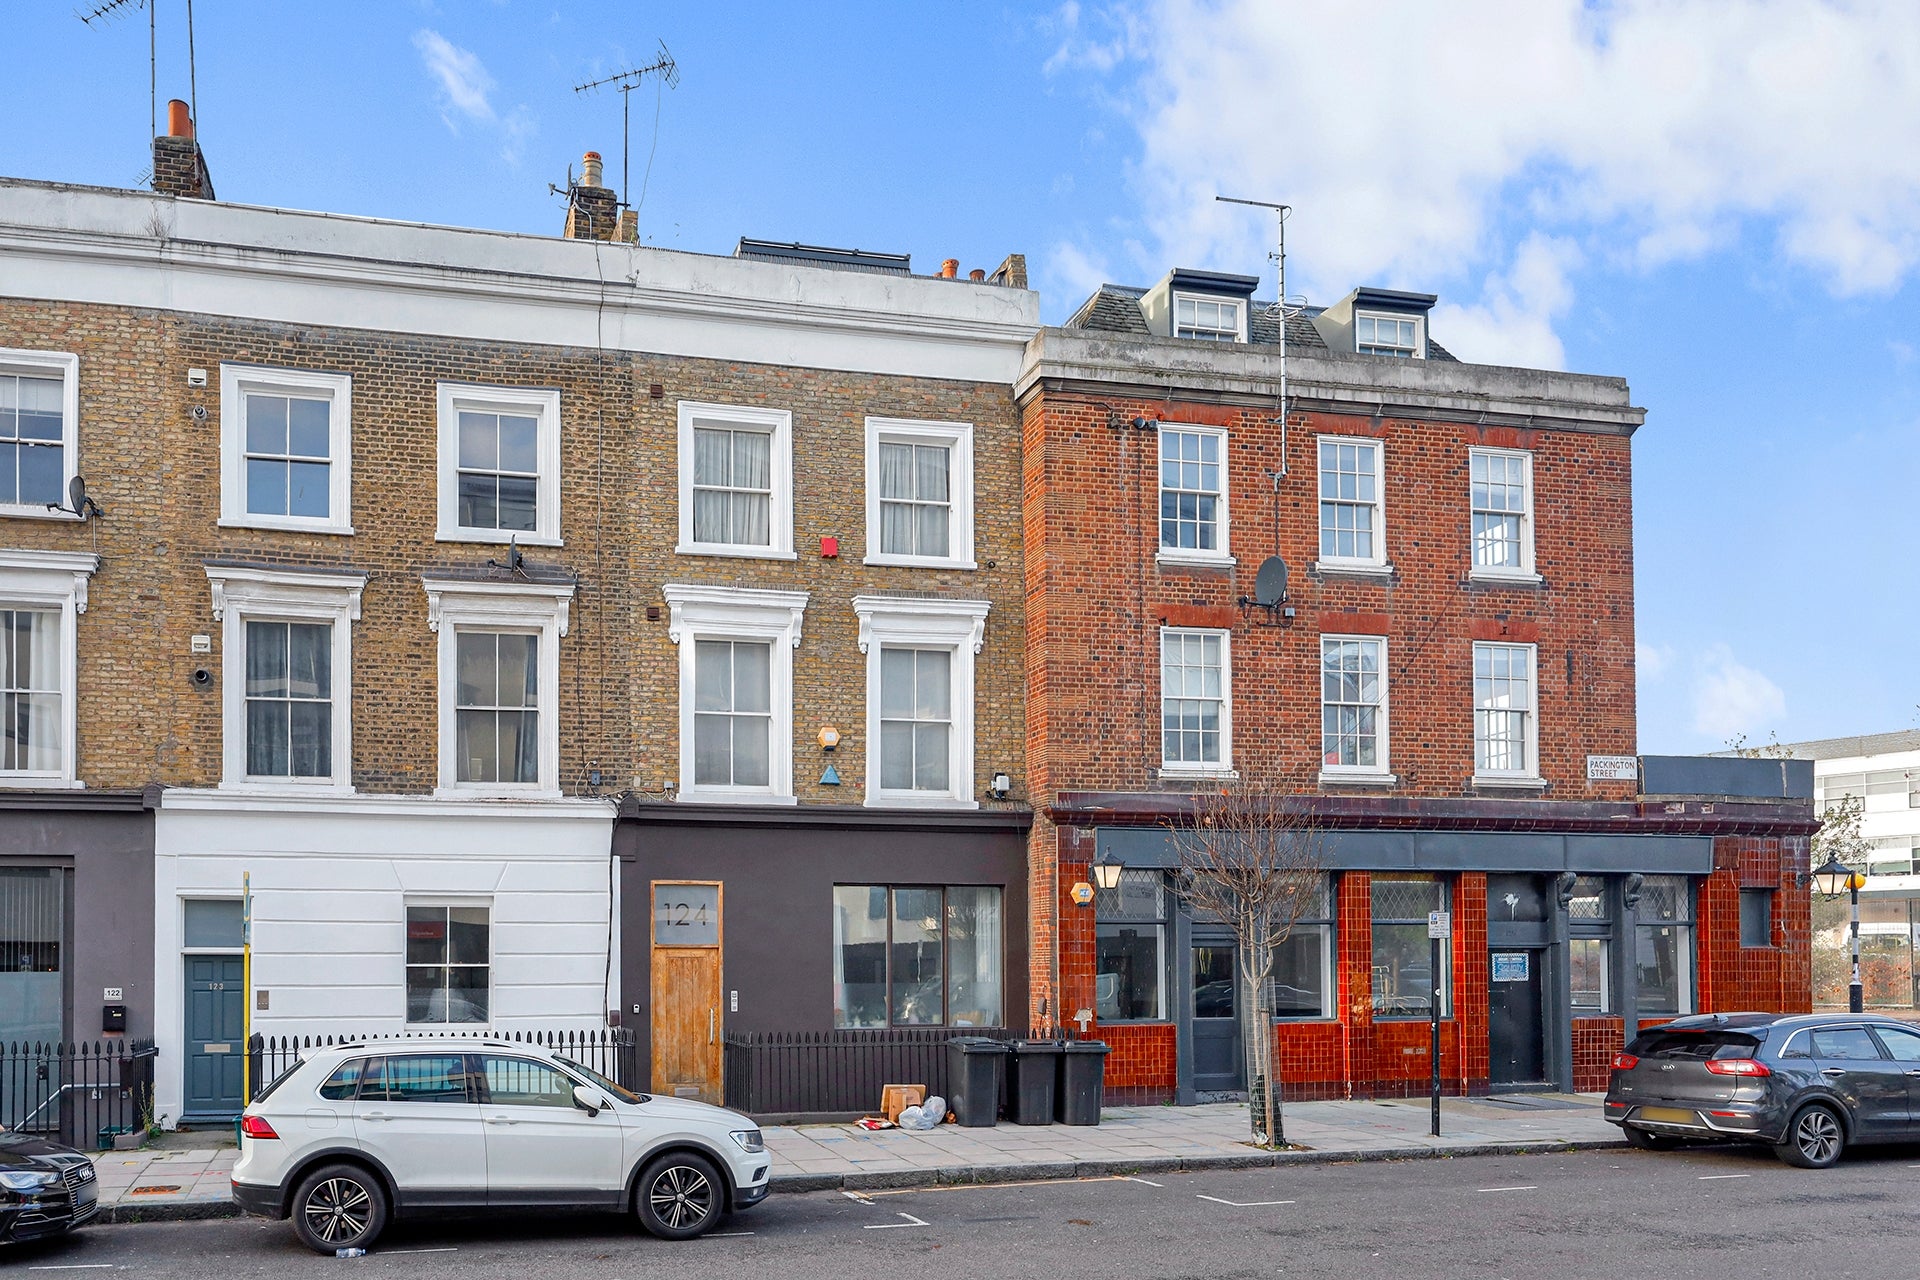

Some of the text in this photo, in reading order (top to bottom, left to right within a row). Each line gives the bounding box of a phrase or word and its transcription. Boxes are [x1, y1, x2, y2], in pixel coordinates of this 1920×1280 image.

[1590, 761, 1635, 769] PACKINGTON
[1590, 769, 1617, 777] STREET
[664, 903, 709, 926] 124
[208, 982, 224, 990] 123
